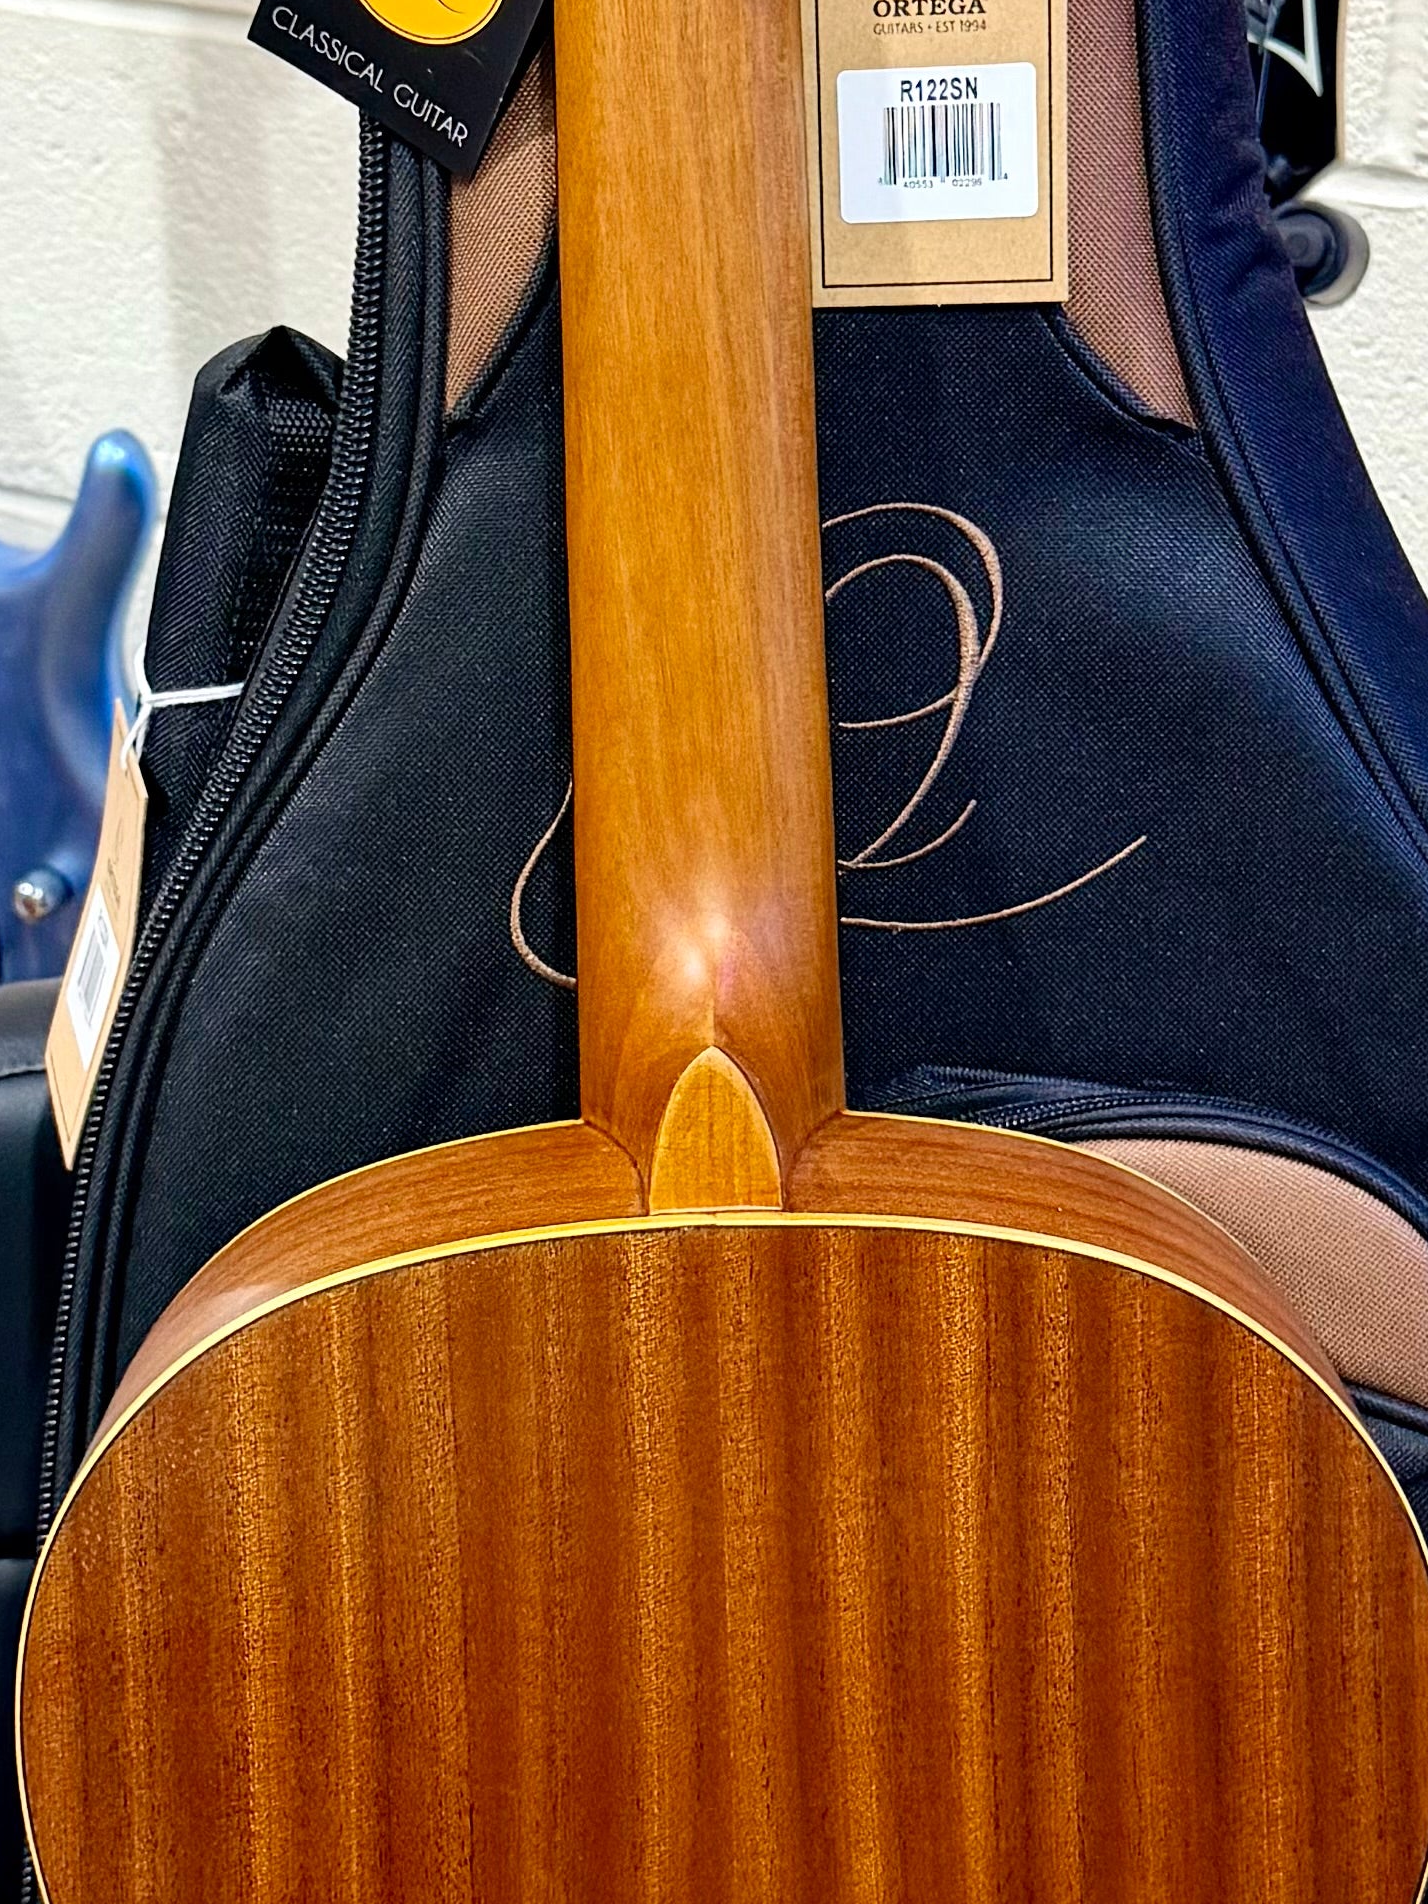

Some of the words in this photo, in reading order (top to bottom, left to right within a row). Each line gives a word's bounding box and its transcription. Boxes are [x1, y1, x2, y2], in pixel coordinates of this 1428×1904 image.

[873, 21, 923, 35] GUITARS
[936, 20, 956, 33] EST
[960, 18, 987, 32] 1994
[271, 5, 385, 95] CLASSICAL
[392, 82, 470, 149] GUITAR
[900, 77, 978, 102] R122SN
